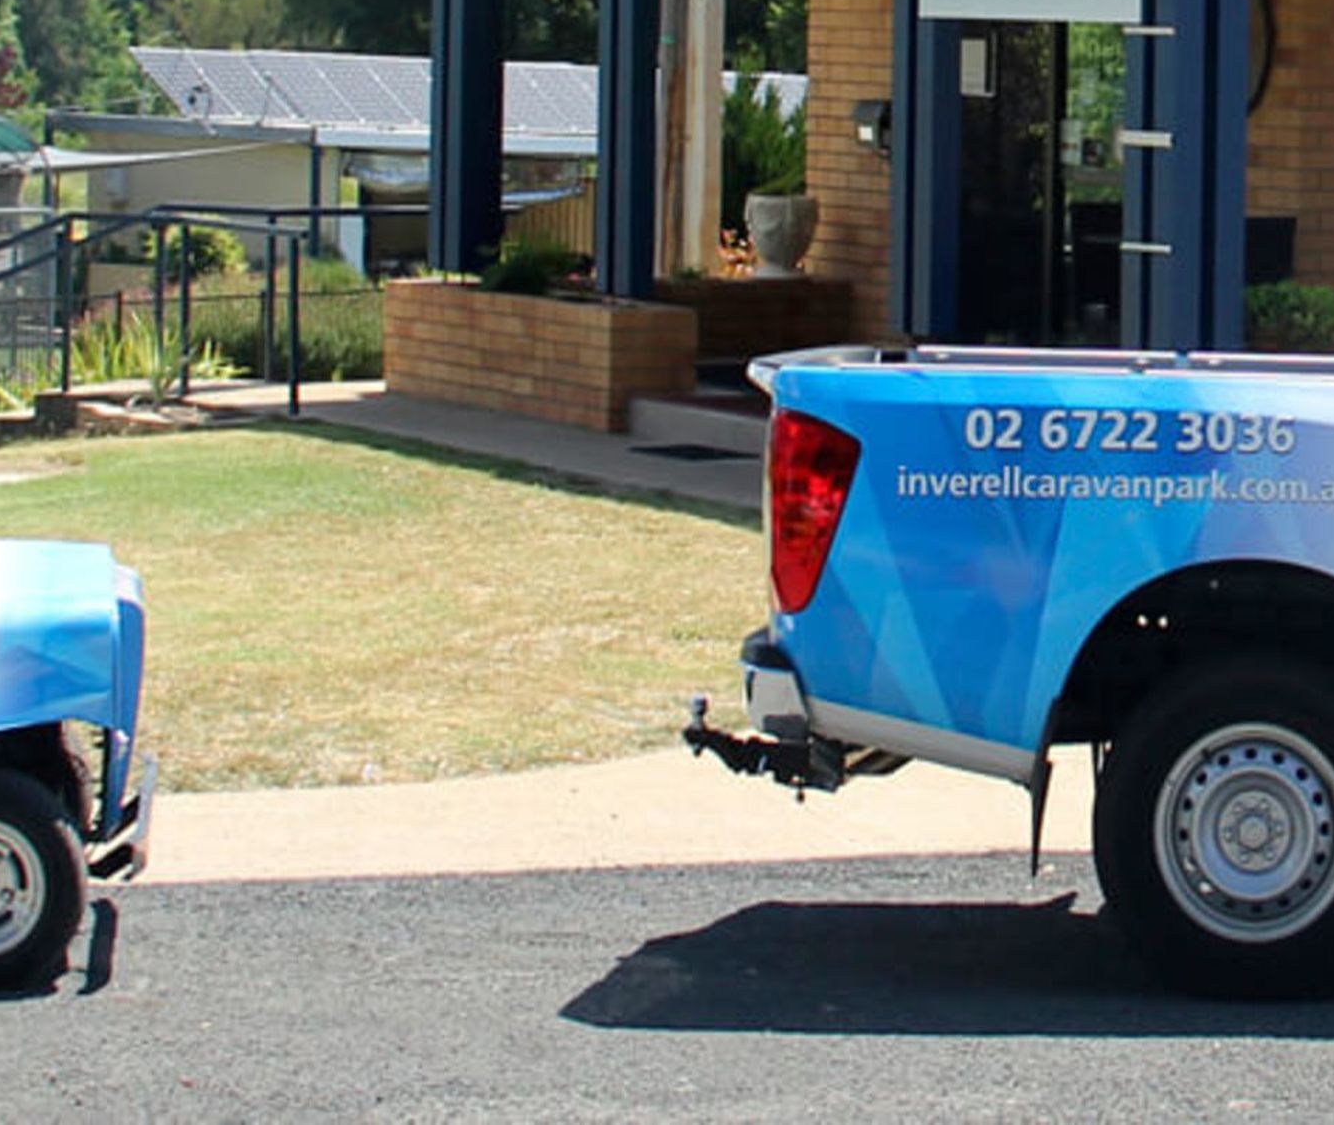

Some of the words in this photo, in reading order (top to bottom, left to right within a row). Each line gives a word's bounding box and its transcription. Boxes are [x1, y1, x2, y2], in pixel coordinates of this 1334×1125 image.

[965, 409, 1023, 449] 02
[1040, 410, 1159, 451] 6722
[1176, 413, 1296, 454] 3036
